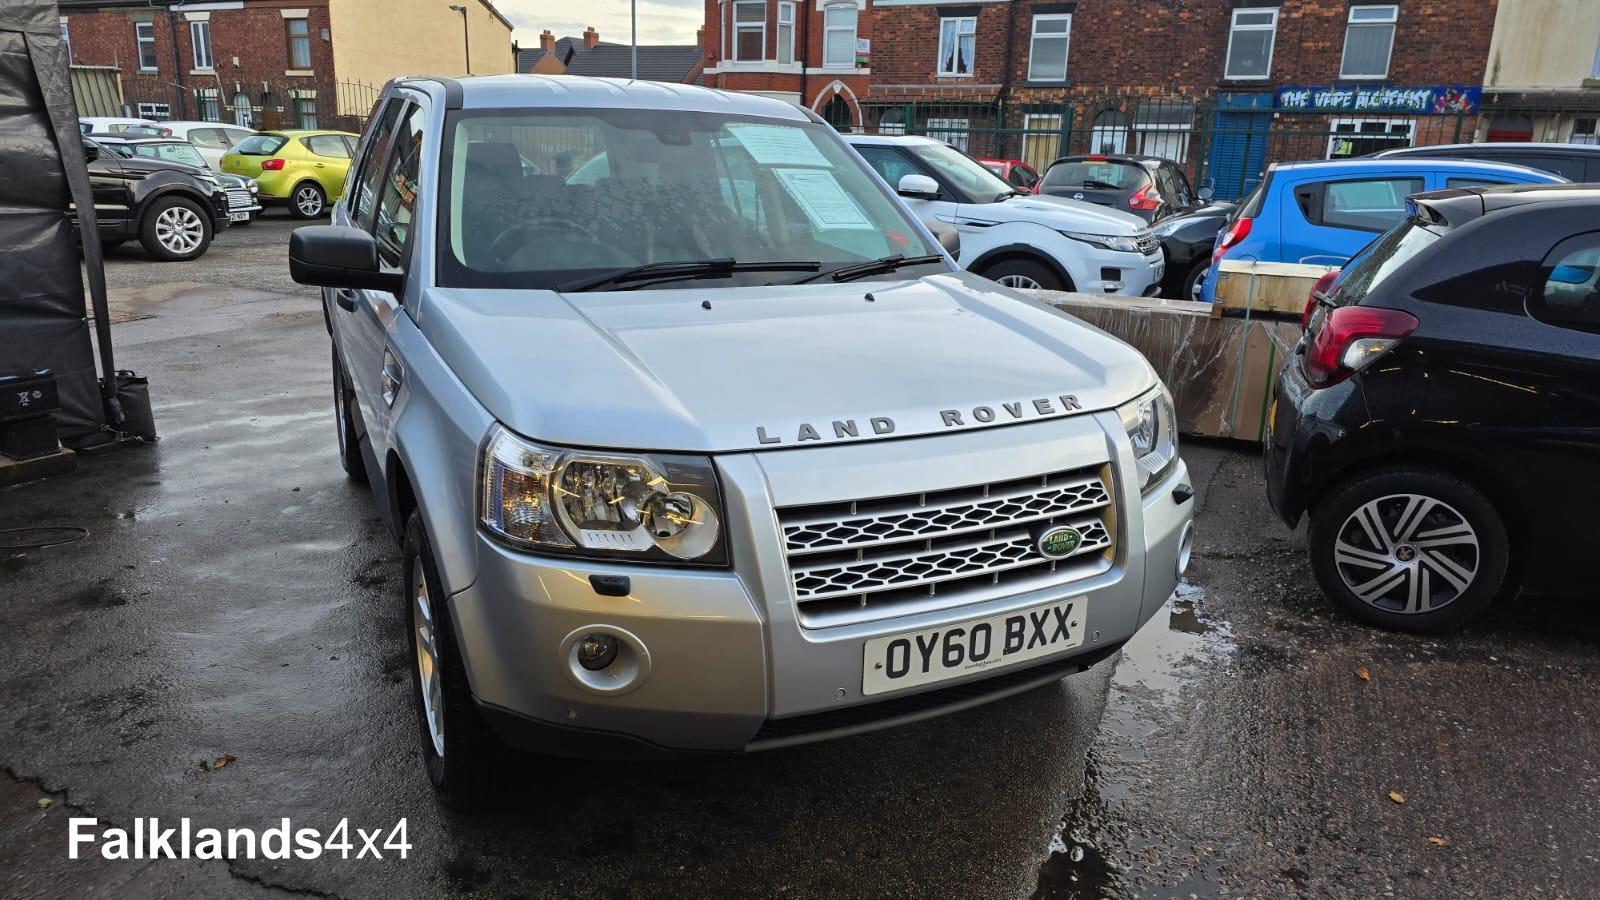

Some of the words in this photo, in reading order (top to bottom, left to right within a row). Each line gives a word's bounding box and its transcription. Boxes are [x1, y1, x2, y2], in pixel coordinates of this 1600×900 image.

[1280, 90, 1310, 107] THE
[1315, 91, 1353, 107] VAPE
[1355, 90, 1431, 109] ALCHEMIST
[756, 416, 896, 444] LAND
[939, 394, 1082, 427] ROVER
[1049, 532, 1069, 543] LAND
[1051, 540, 1075, 551] ROVER
[886, 623, 991, 679] OY60
[1002, 603, 1073, 656] BXX
